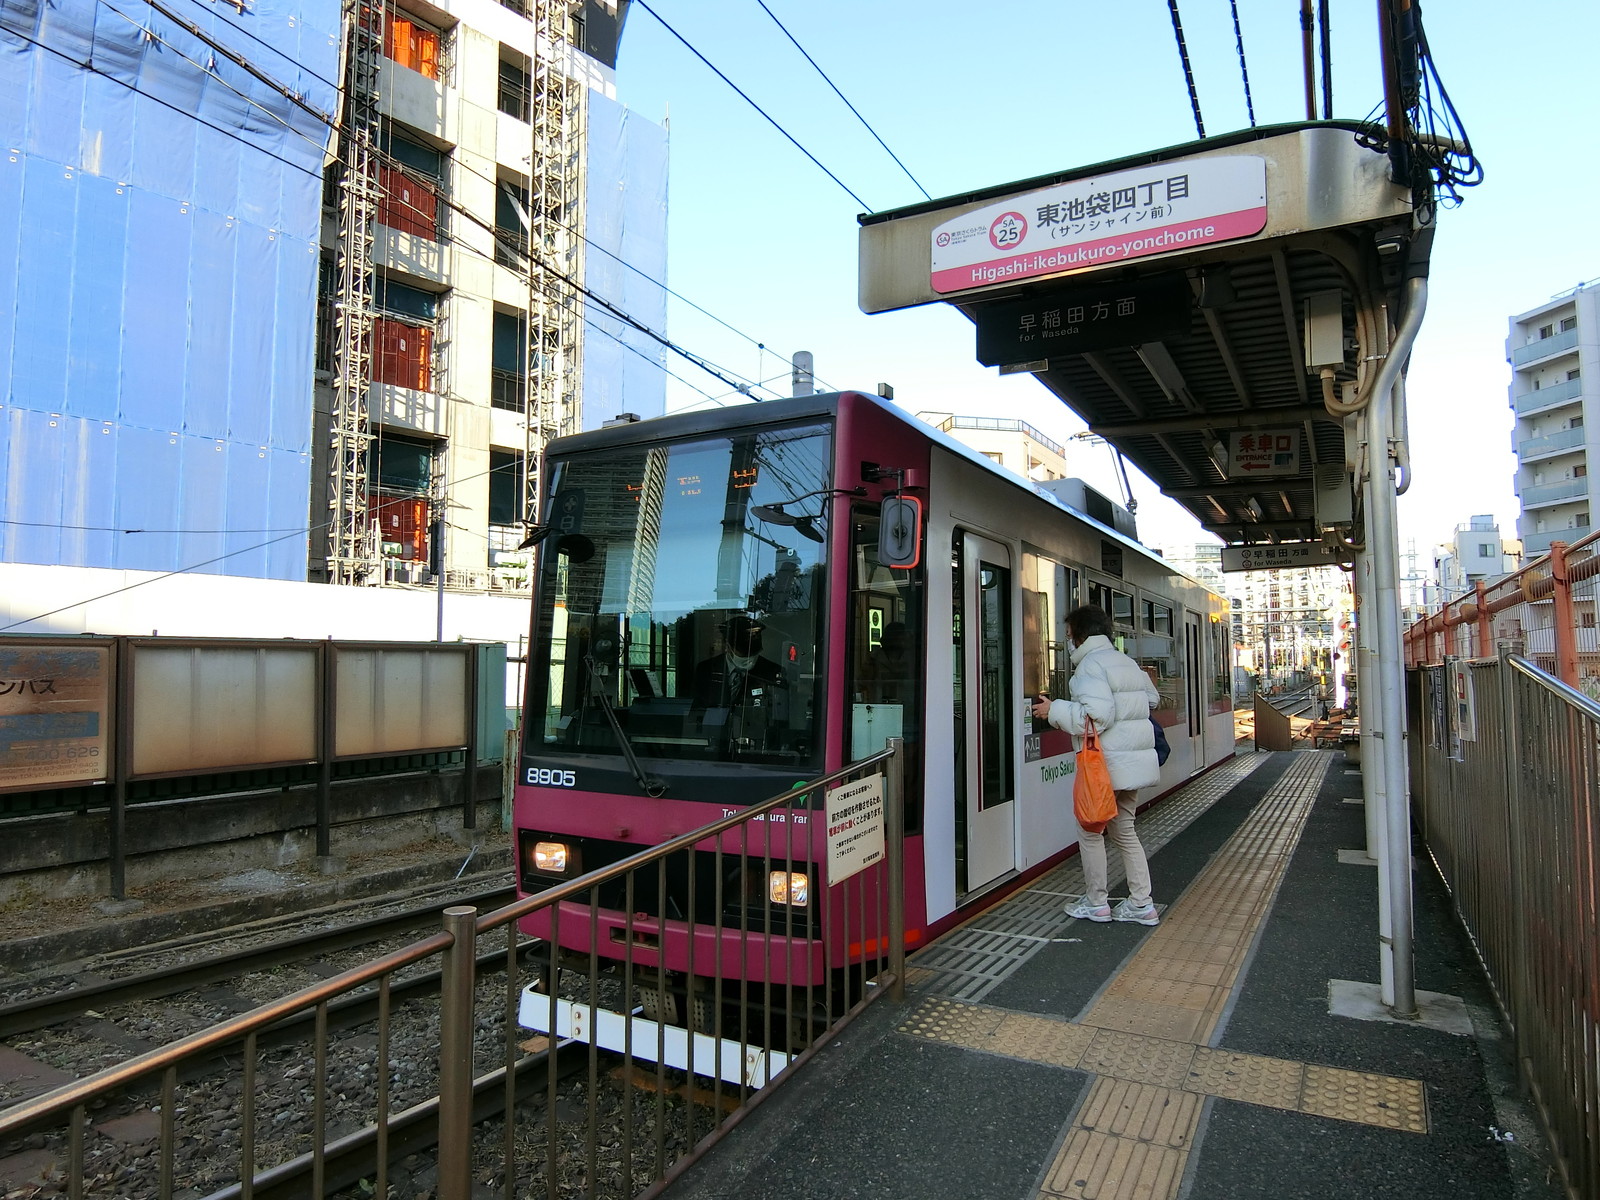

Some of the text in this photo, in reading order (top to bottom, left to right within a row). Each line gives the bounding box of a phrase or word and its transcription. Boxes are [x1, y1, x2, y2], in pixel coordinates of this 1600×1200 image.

[1036, 174, 1189, 228] 東池袋四丁目
[1002, 218, 1015, 228] SA
[998, 227, 1018, 243] 25
[971, 225, 1215, 281] Higashi-ikebukuro-yonchome
[1018, 297, 1136, 332] 早稲田方面
[1018, 326, 1079, 342] for Waseda
[1239, 433, 1291, 452] 乗車口
[1254, 548, 1309, 559] 早稲田方面
[527, 767, 576, 787] 8905
[1041, 765, 1058, 783] Tokyo
